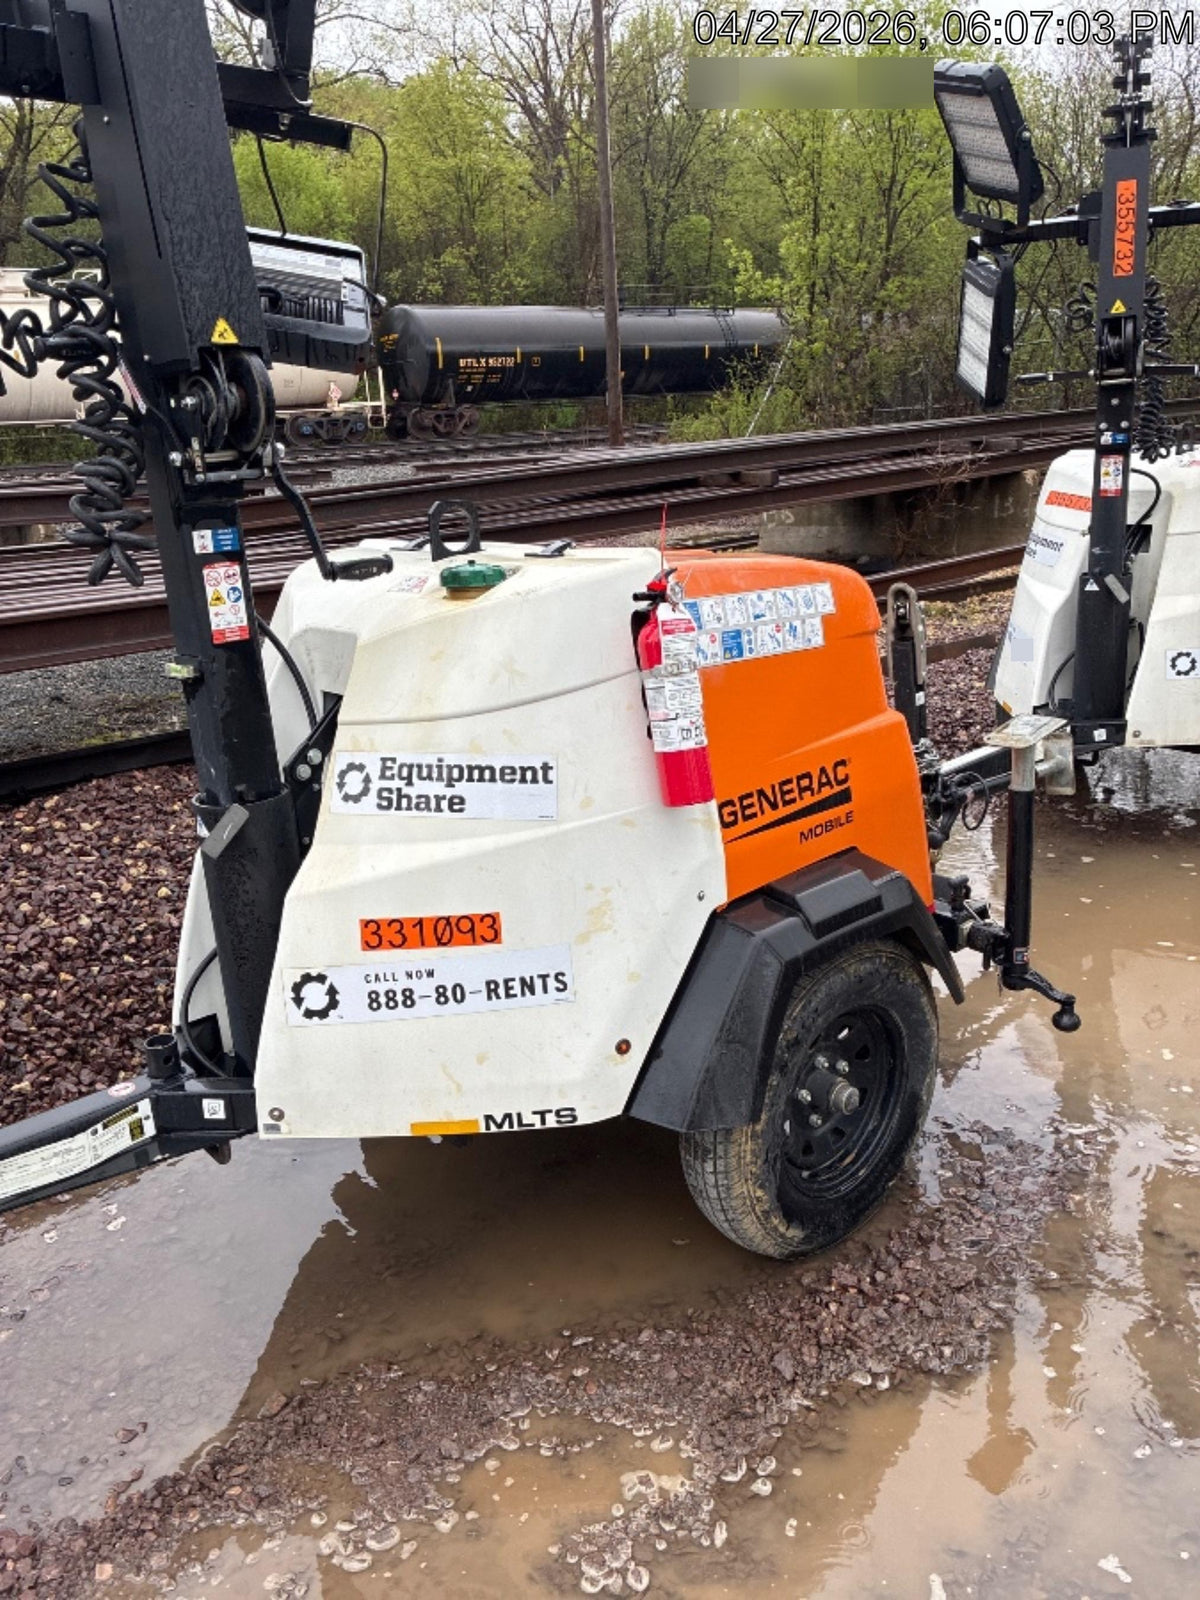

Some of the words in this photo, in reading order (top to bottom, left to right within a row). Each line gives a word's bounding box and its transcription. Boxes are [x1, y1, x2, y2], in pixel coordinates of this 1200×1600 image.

[1114, 193, 1135, 274] 355732
[378, 757, 554, 788] Equipment
[376, 787, 466, 813] Share
[718, 758, 850, 829] GENERAC
[799, 810, 854, 845] MOBILE
[363, 914, 500, 949] 331093
[364, 972, 399, 984] CALL
[405, 968, 435, 981] NOW
[367, 971, 569, 1012] 888-80-RENTS
[483, 1107, 578, 1131] MLTS
